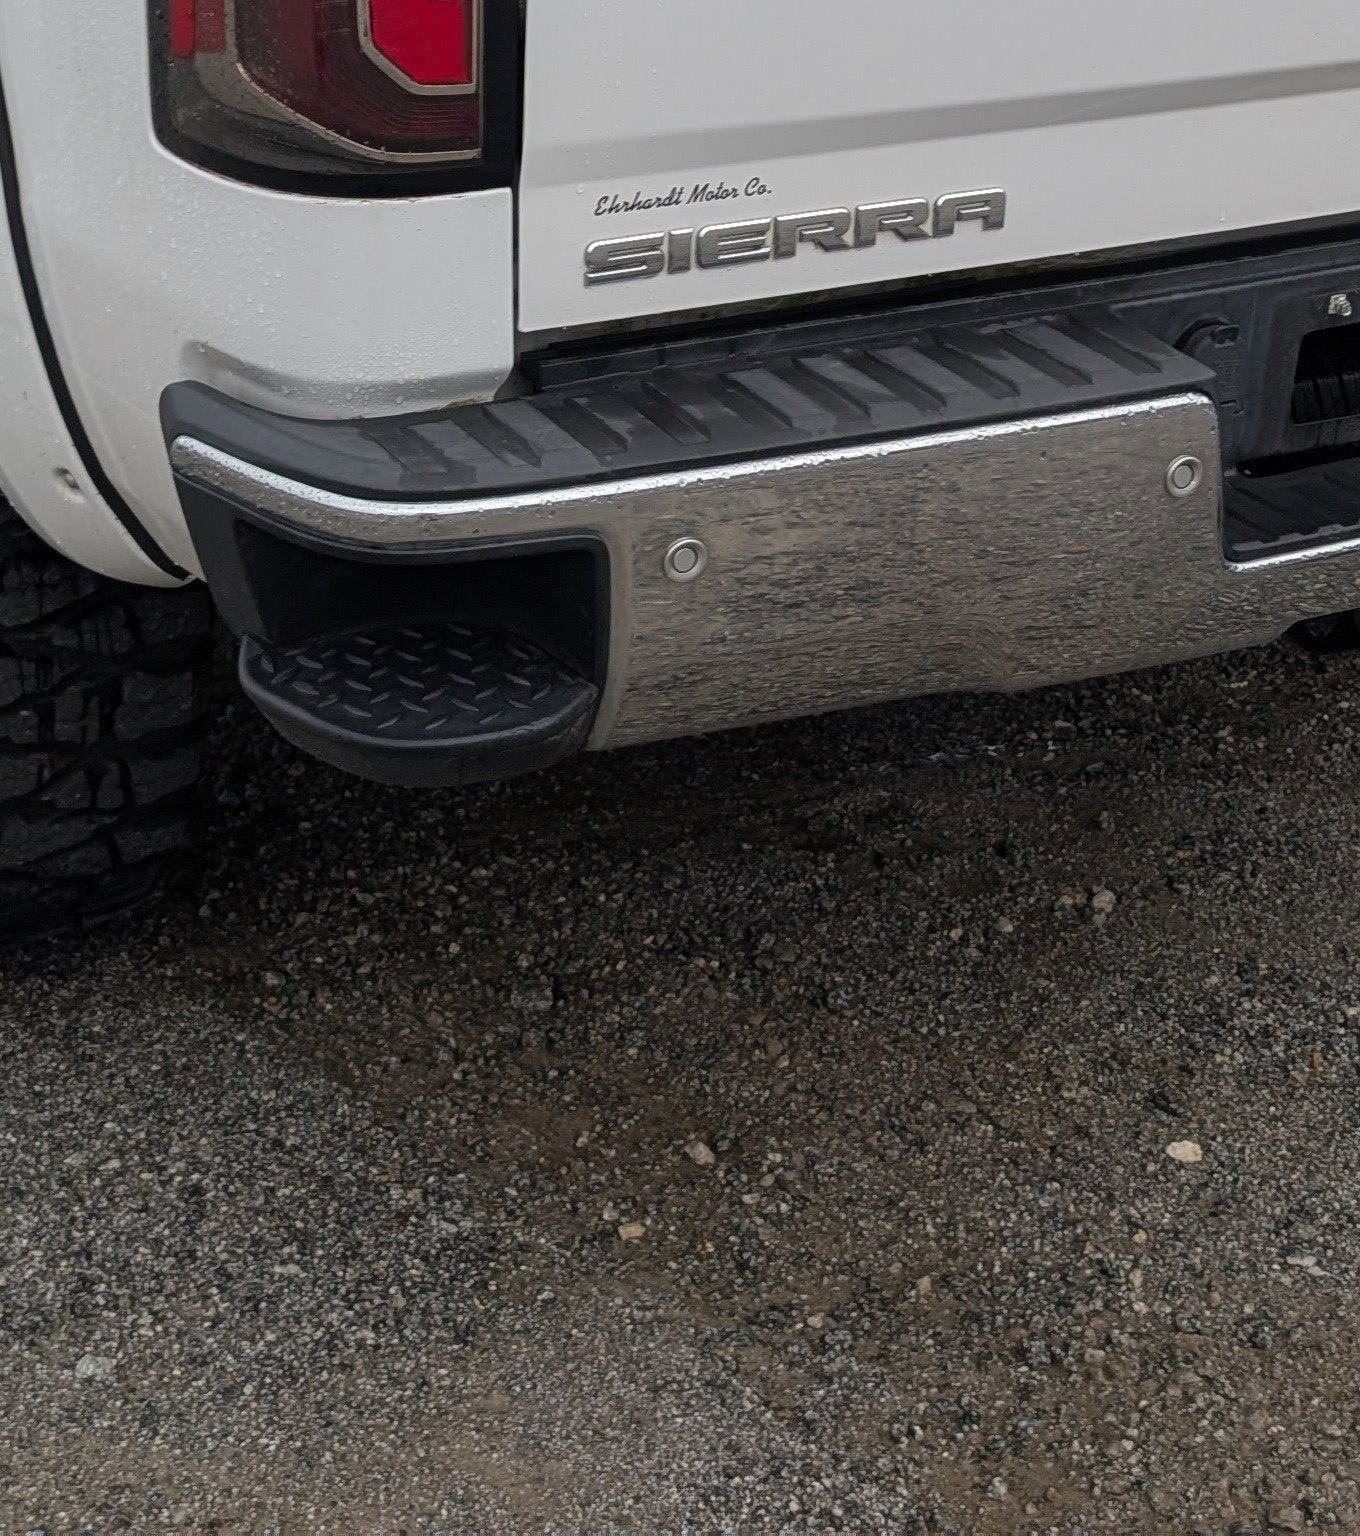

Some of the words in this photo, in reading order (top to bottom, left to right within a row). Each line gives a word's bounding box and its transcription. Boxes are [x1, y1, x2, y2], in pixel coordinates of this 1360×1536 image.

[594, 186, 685, 216] Ehrhardt
[686, 181, 740, 205] Motor
[744, 176, 773, 197] Co.
[583, 187, 1006, 286] SIERRA
